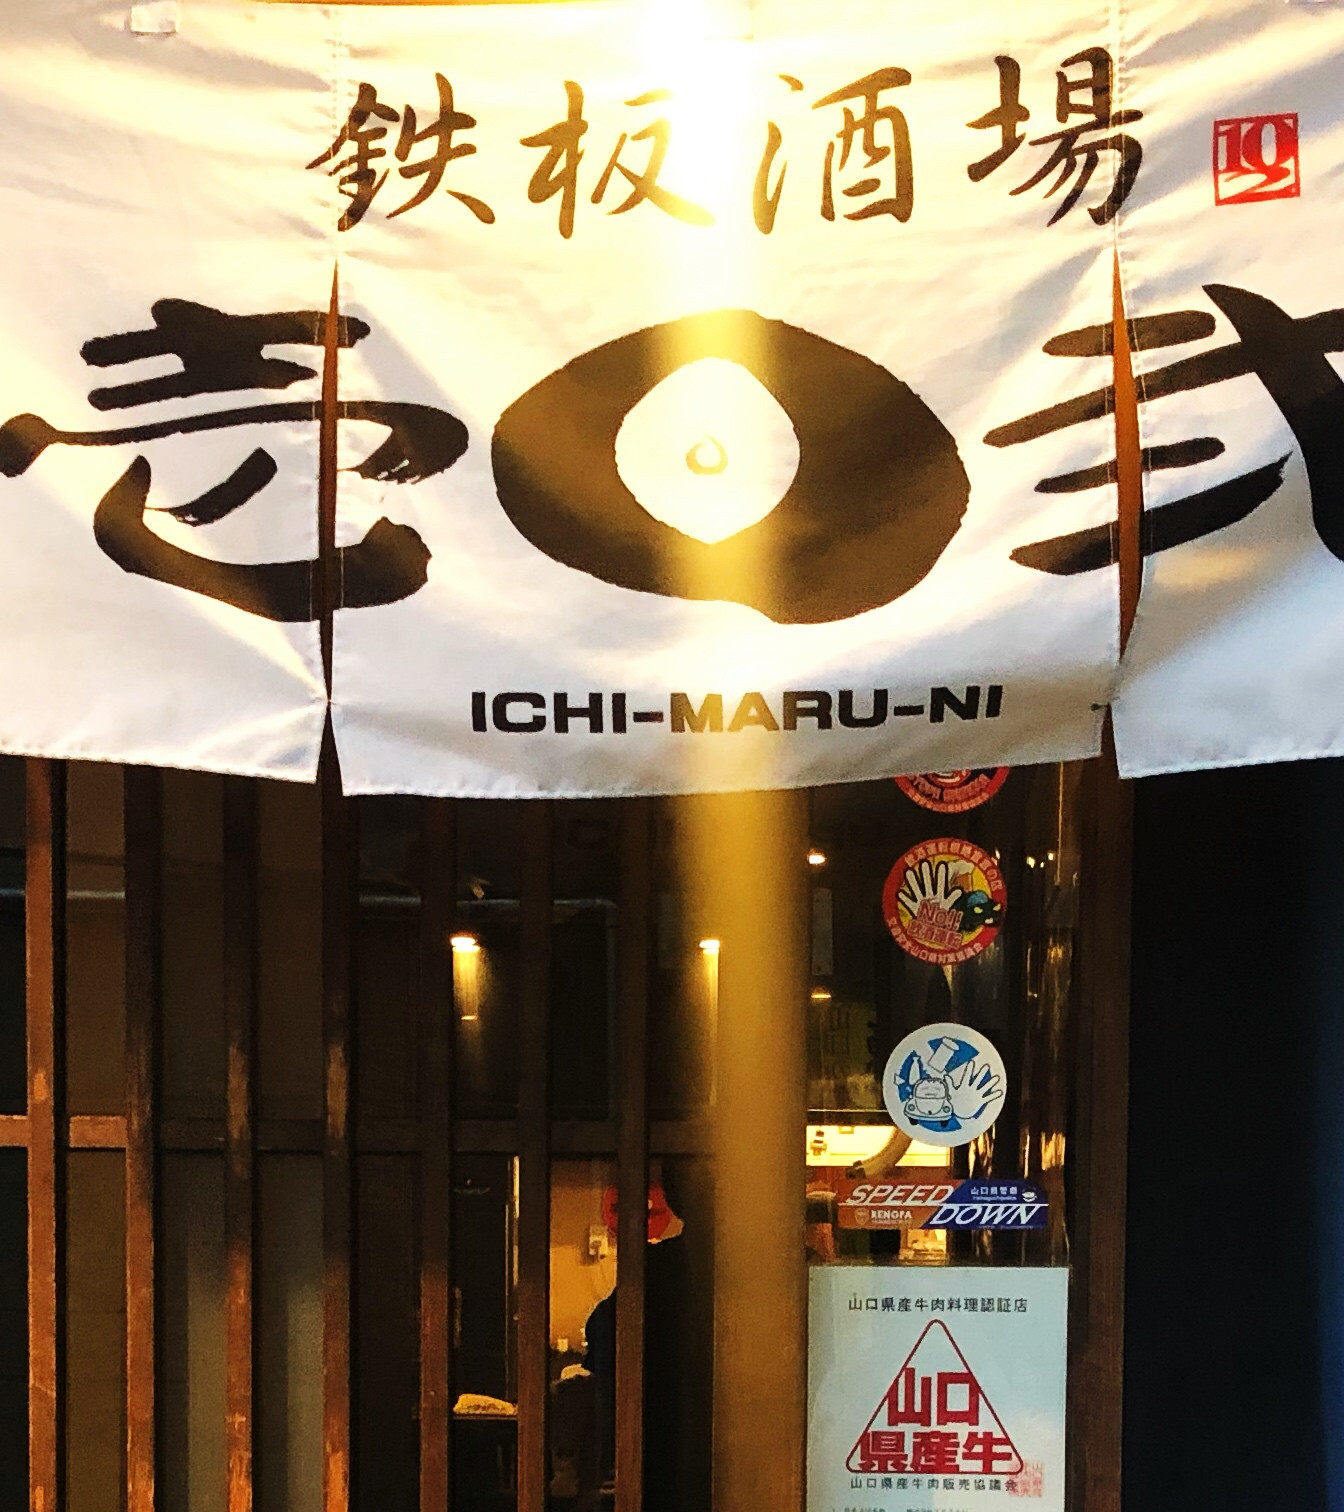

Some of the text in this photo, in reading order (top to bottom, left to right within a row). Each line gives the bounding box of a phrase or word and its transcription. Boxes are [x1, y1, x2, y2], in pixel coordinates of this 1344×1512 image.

[307, 46, 1145, 236] 鉄板酒場
[471, 685, 1004, 733] ICHI-MARU-NI
[846, 1185, 955, 1205] SPEED
[929, 1205, 1041, 1225] DOWN
[848, 1294, 1028, 1313] 山口県産牛肉料理認証店
[886, 1367, 983, 1427] 山口
[857, 1431, 1014, 1473] 県産牛
